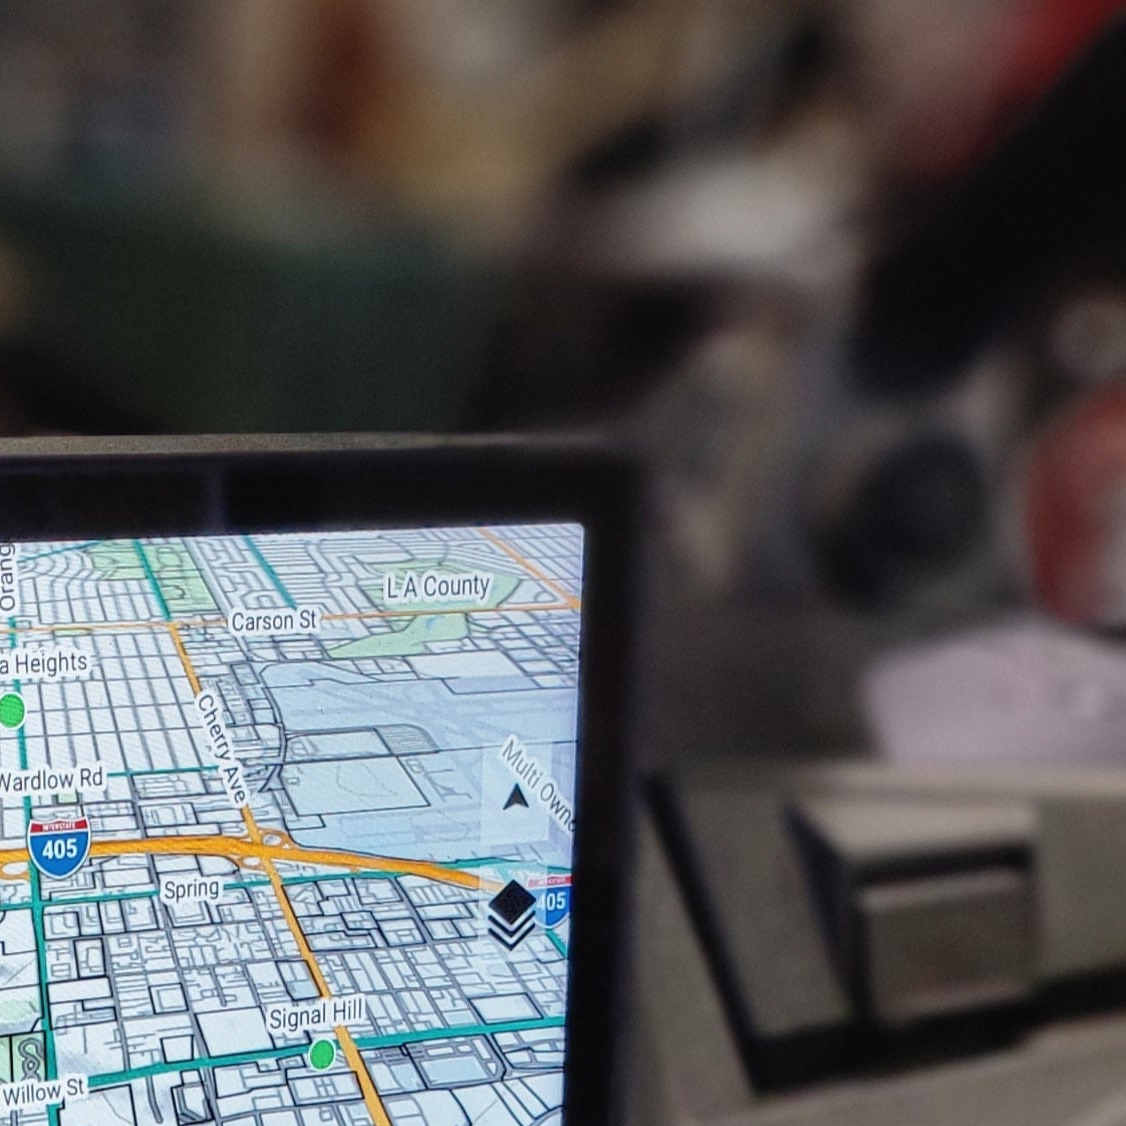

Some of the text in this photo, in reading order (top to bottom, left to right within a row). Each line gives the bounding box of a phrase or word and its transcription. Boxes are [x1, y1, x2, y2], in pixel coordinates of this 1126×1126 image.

[387, 574, 490, 600] L A County
[232, 609, 317, 632] Carson St
[15, 650, 88, 678] Heights
[198, 693, 246, 804] Cherry Ave
[80, 766, 103, 787] Rd
[502, 739, 544, 789] Multi
[42, 838, 78, 859] 405
[164, 879, 219, 902] Spring
[270, 998, 361, 1032] Signal Hill
[3, 1084, 62, 1106] Willow
[66, 1078, 84, 1097] St
